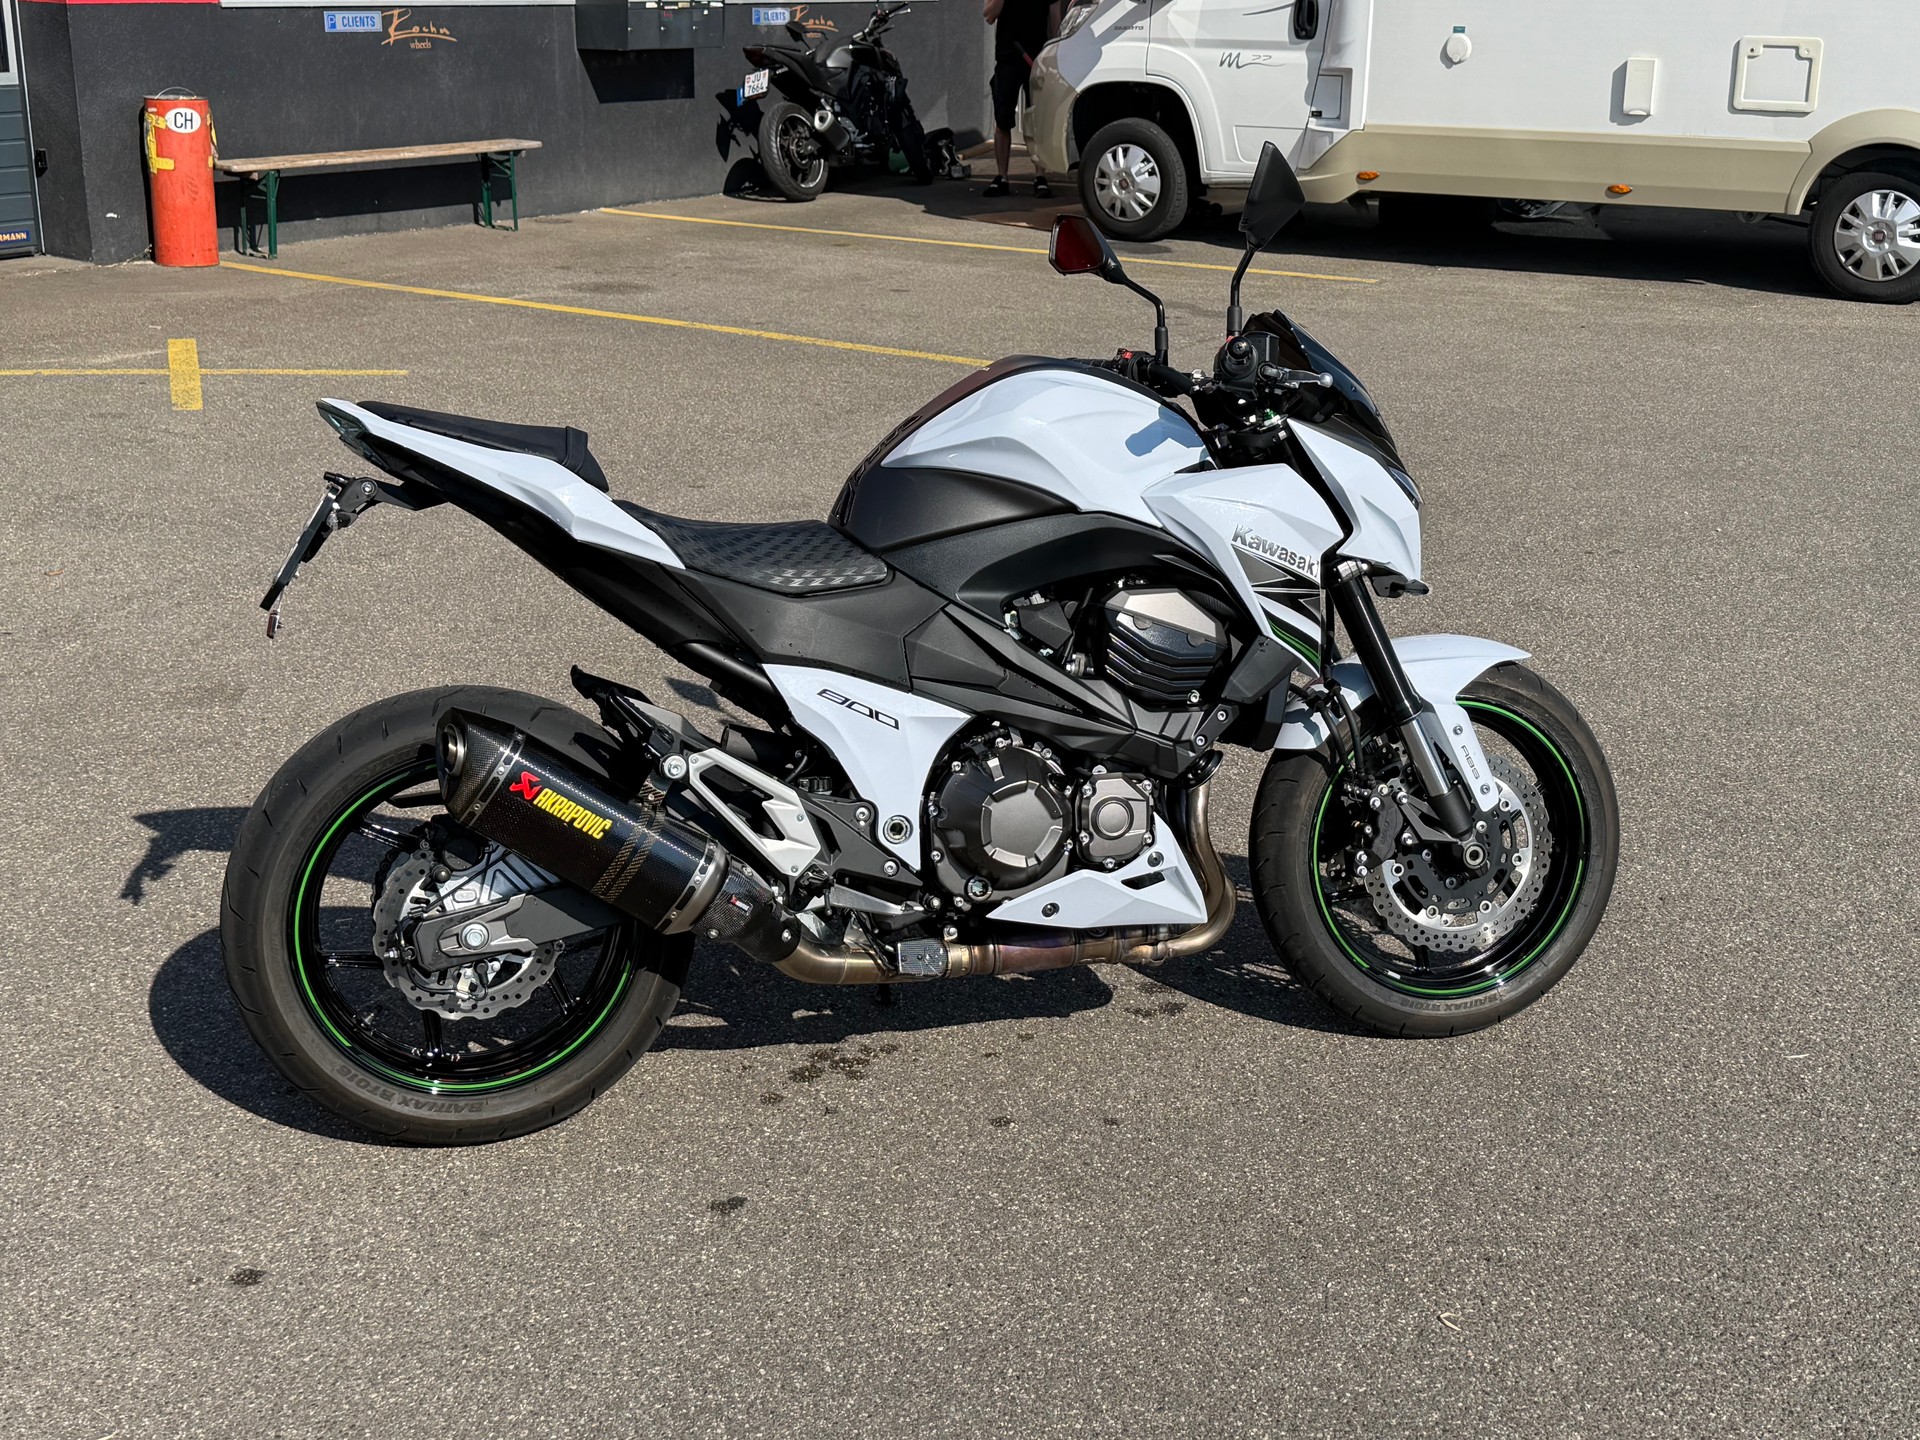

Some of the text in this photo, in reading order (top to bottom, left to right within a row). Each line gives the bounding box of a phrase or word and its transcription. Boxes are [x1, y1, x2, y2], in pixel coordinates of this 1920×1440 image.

[341, 15, 376, 28] CLIENTS
[763, 11, 787, 22] CLIENTS
[410, 39, 432, 49] wheels
[752, 72, 762, 84] JU
[173, 111, 194, 130] CH
[1231, 523, 1320, 579] Kawasaki
[817, 688, 900, 731] 800
[1460, 744, 1480, 780] ABS
